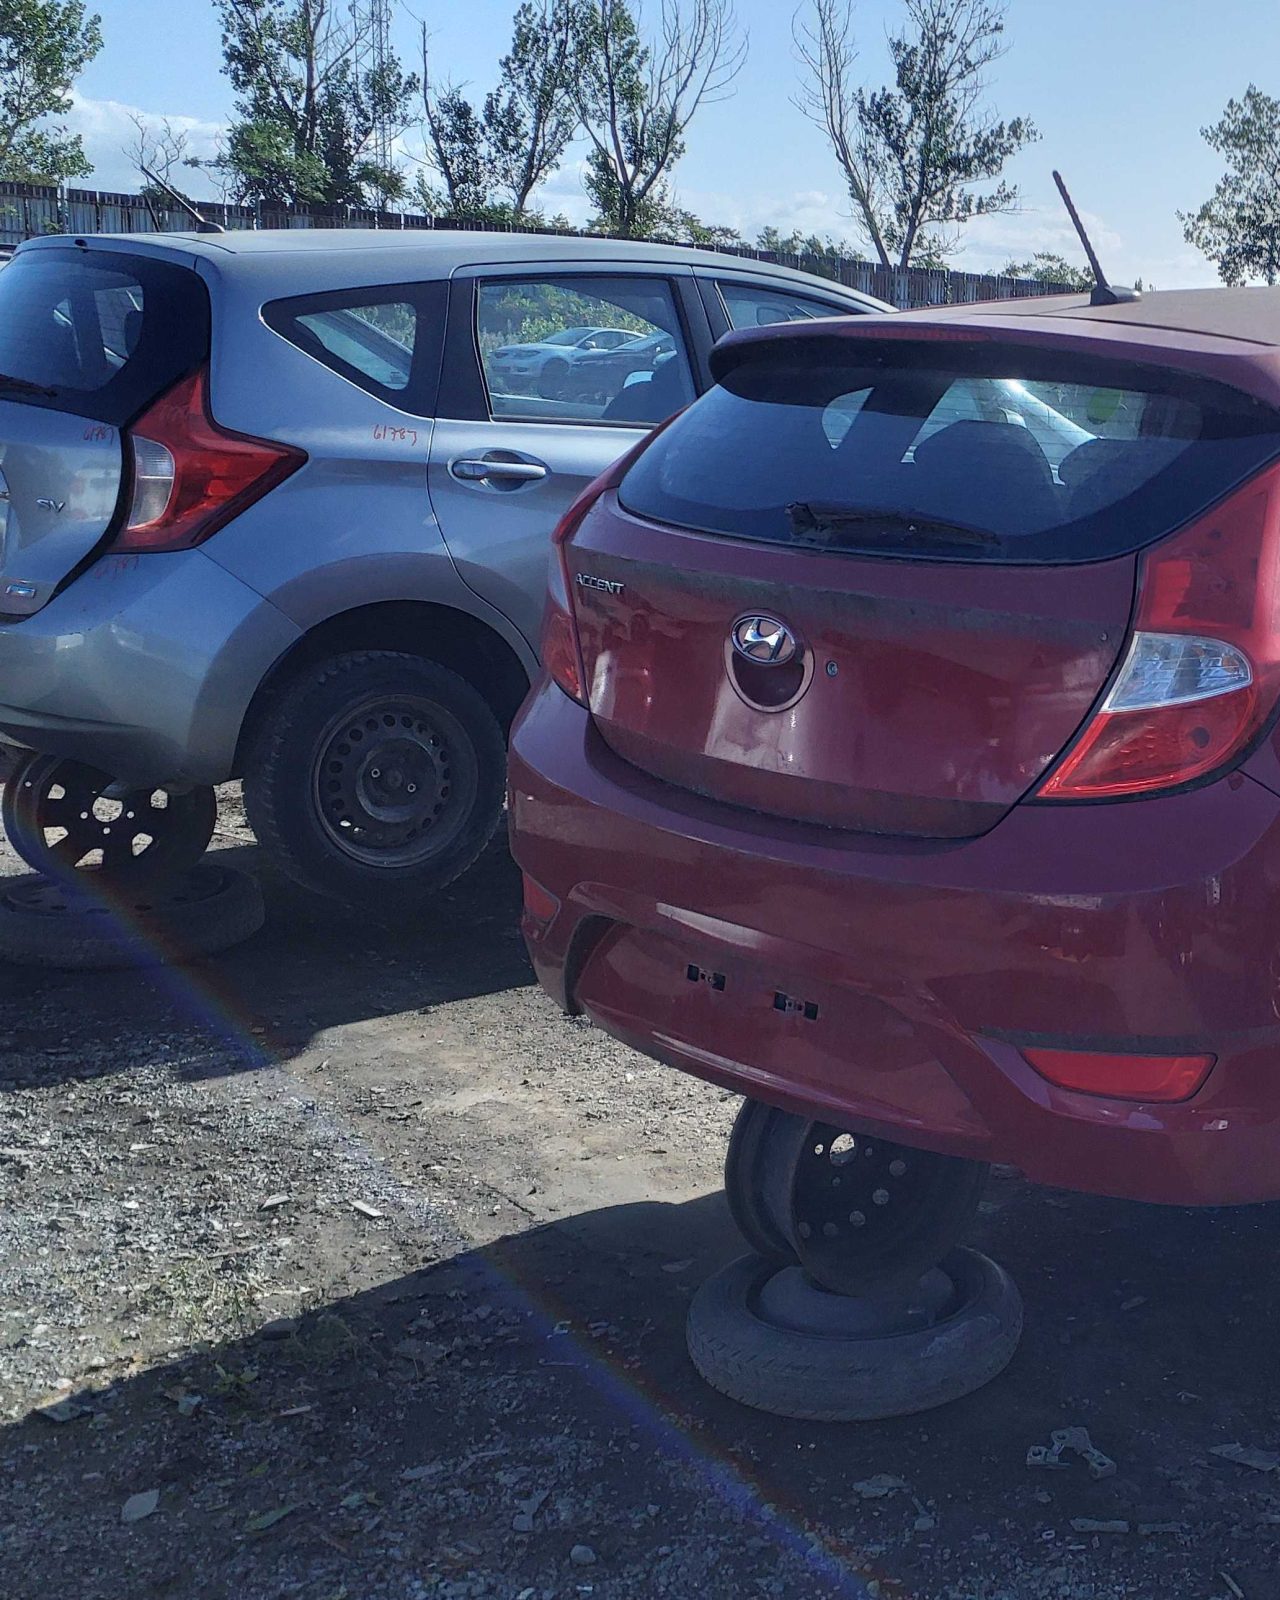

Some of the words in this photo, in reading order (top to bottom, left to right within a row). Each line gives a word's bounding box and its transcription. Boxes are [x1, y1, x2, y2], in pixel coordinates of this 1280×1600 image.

[373, 424, 418, 447] 61787
[36, 498, 66, 513] SV
[576, 572, 625, 595] ACCENT
